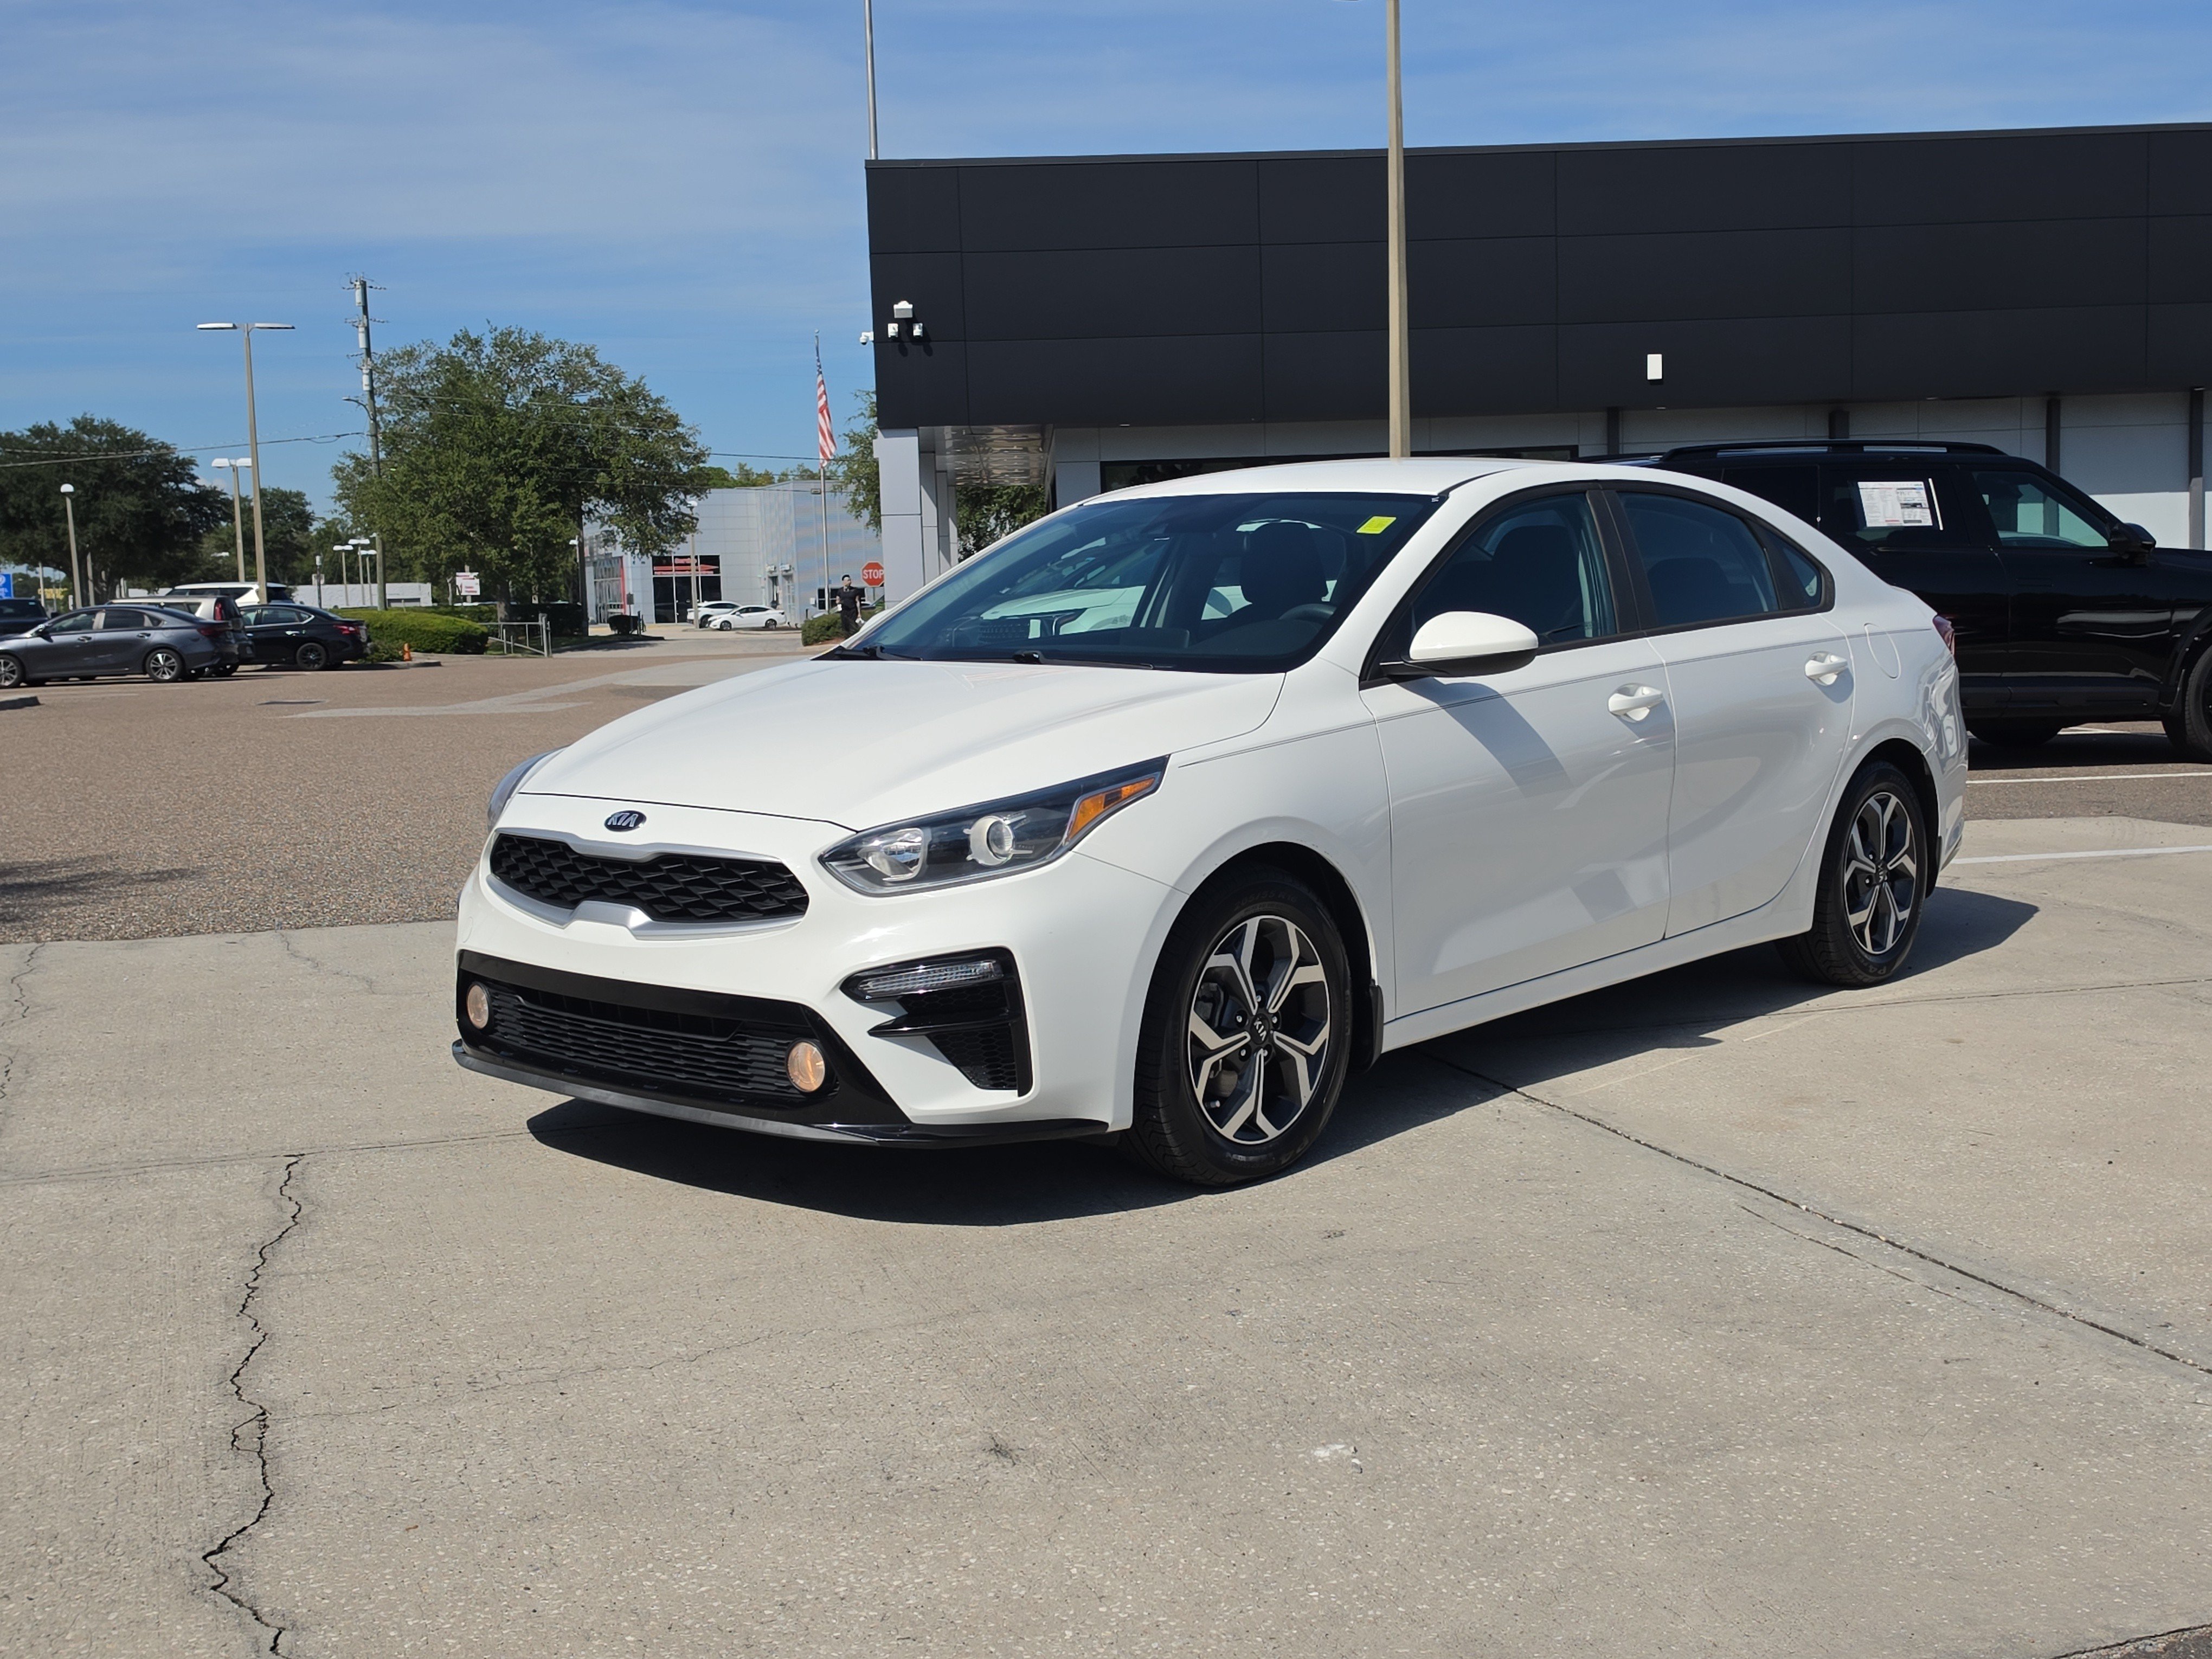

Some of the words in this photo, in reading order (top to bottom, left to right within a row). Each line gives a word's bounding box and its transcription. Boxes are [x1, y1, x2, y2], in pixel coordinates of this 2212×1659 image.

[863, 569, 884, 579] STOP
[607, 813, 639, 827] KIA
[1253, 1017, 1266, 1041] KIA
